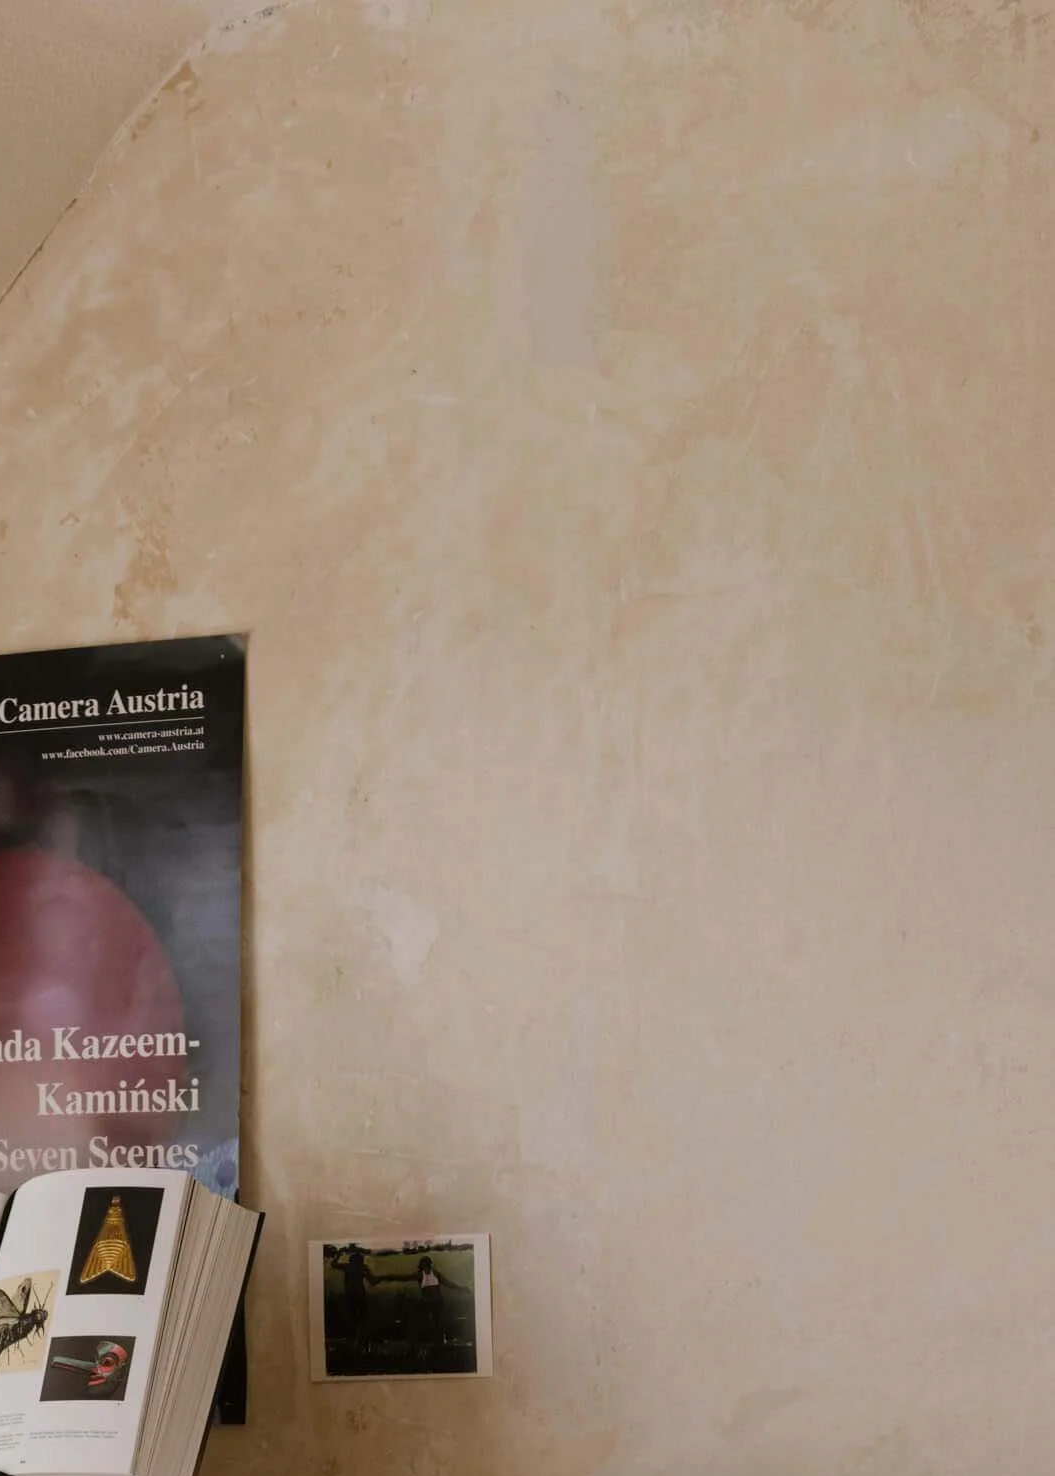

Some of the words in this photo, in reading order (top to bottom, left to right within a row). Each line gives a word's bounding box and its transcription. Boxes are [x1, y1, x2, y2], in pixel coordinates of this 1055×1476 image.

[106, 684, 204, 716] Austria
[41, 740, 204, 761] www.facebook.com/Camera.Austria
[98, 726, 204, 742] www.camera-austria.at
[52, 1024, 200, 1062] Kazeem-
[37, 1078, 200, 1117] Kamiński
[88, 1136, 200, 1170] Scenes
